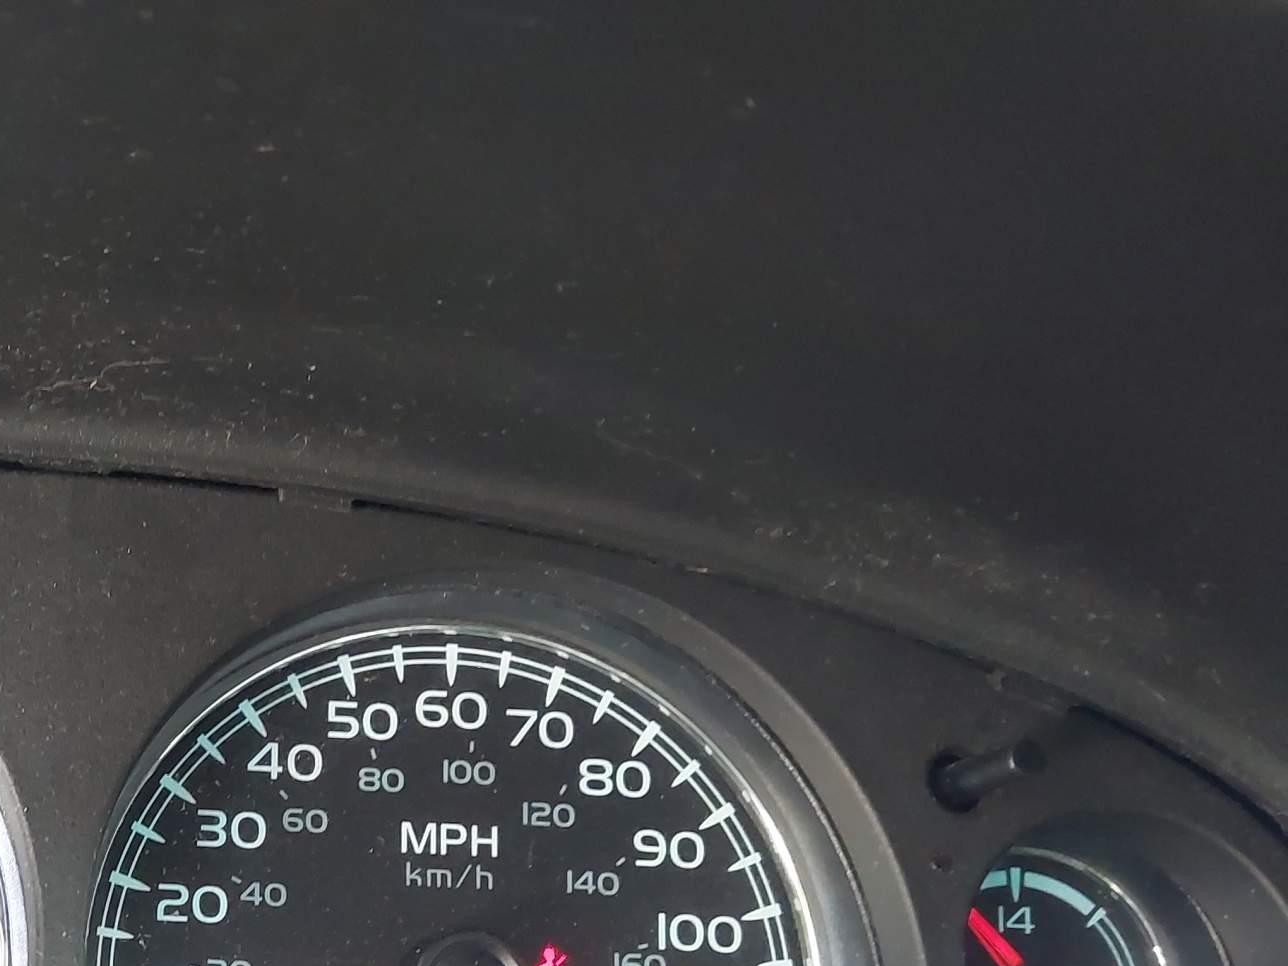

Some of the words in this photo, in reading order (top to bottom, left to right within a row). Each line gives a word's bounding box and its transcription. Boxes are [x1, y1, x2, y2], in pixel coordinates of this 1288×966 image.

[326, 701, 399, 741] 50
[415, 690, 488, 730] 60
[505, 709, 574, 749] 70
[247, 743, 323, 783] 40
[357, 767, 405, 794] 80
[441, 759, 496, 786] 100
[578, 759, 652, 799] 80
[197, 810, 267, 850] 30
[282, 808, 329, 835] 60
[521, 801, 576, 829] 120
[399, 822, 499, 858] MPH
[633, 830, 705, 870] 90
[239, 882, 287, 908] 40
[405, 863, 494, 891] km/h
[566, 870, 620, 897] 140
[156, 884, 229, 924] 20
[997, 904, 1036, 935] 14
[657, 914, 743, 954] 100
